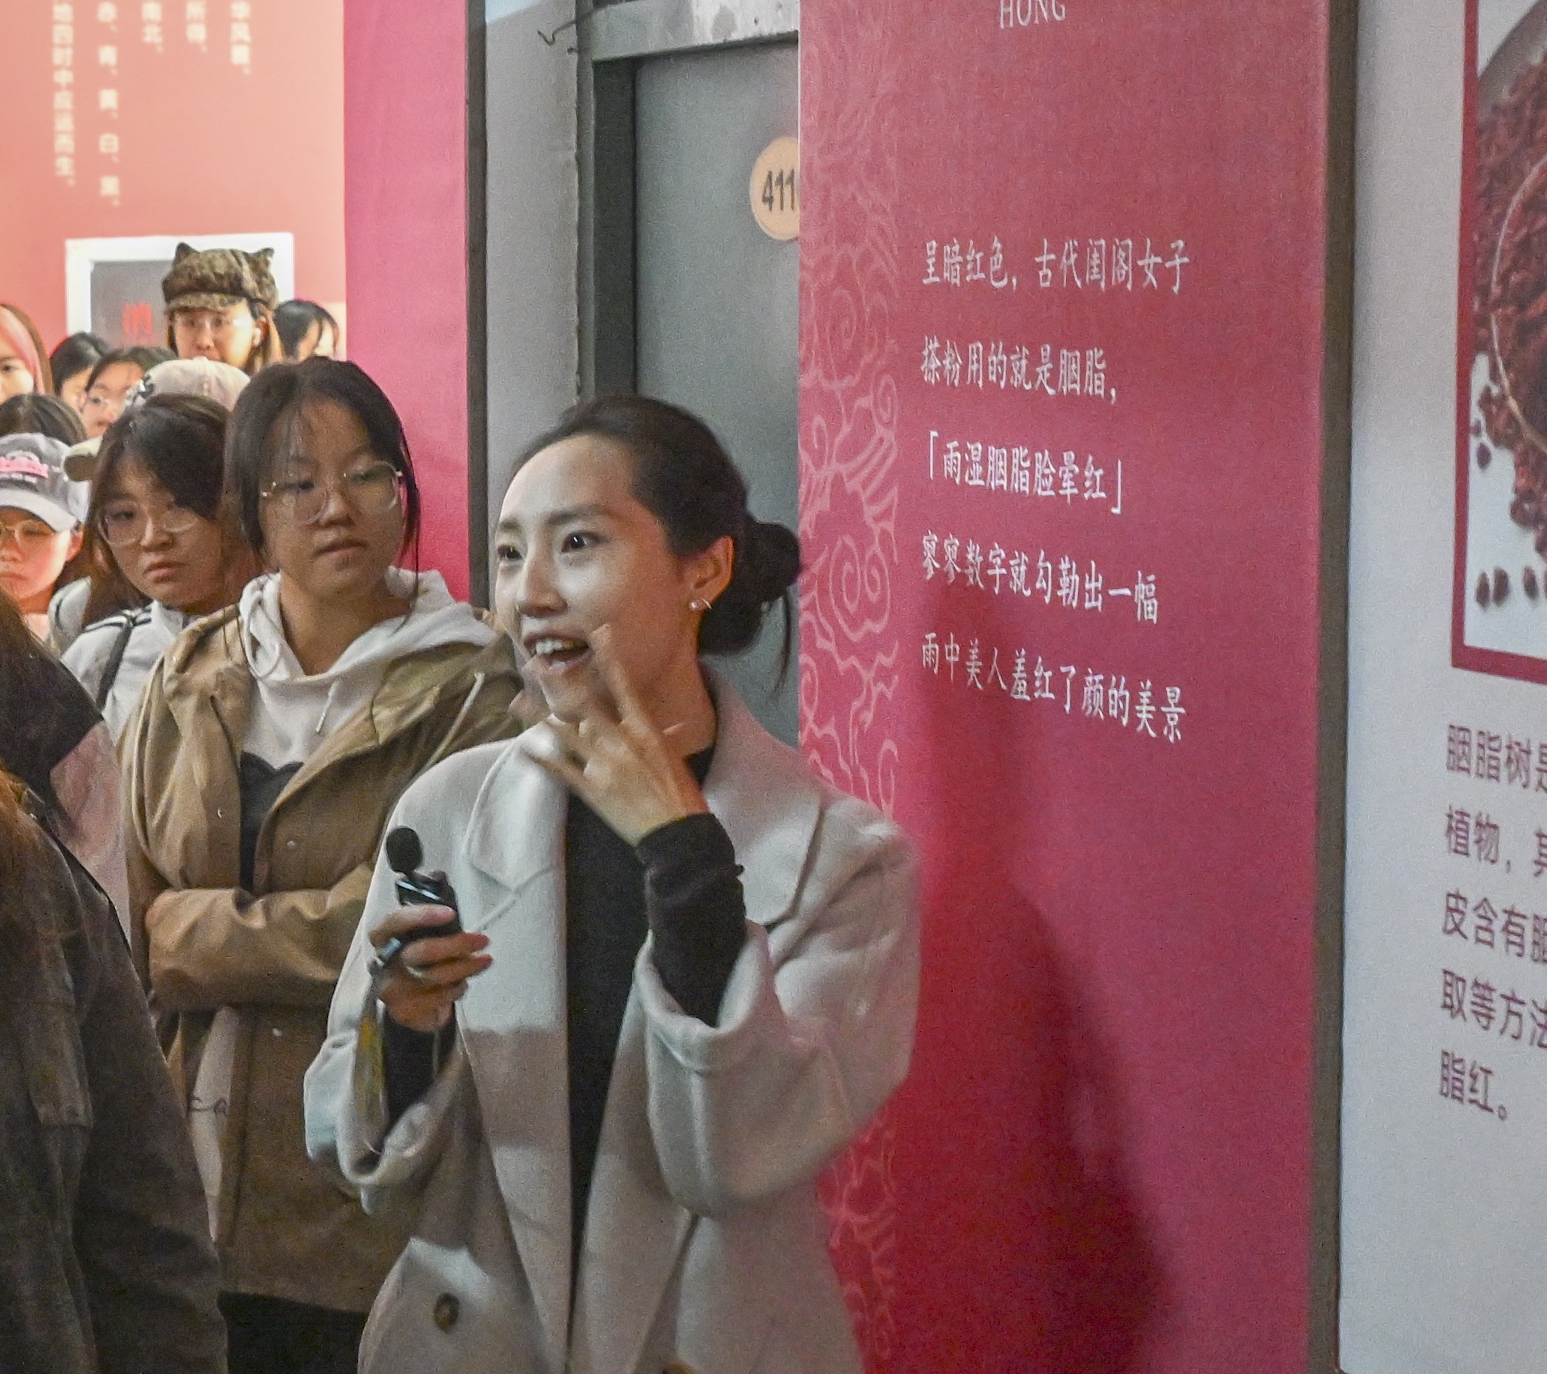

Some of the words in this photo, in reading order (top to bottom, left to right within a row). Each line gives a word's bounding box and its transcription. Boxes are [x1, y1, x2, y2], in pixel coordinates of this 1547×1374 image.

[761, 168, 795, 212] 411
[922, 235, 1191, 295] 呈暗红色，古代闺阁女子
[921, 529, 1159, 625] 寥寥数字就勾勒出一幅
[921, 631, 1187, 744] 雨中美人羞红了颜的美景
[1439, 1050, 1508, 1122] 脂红。
